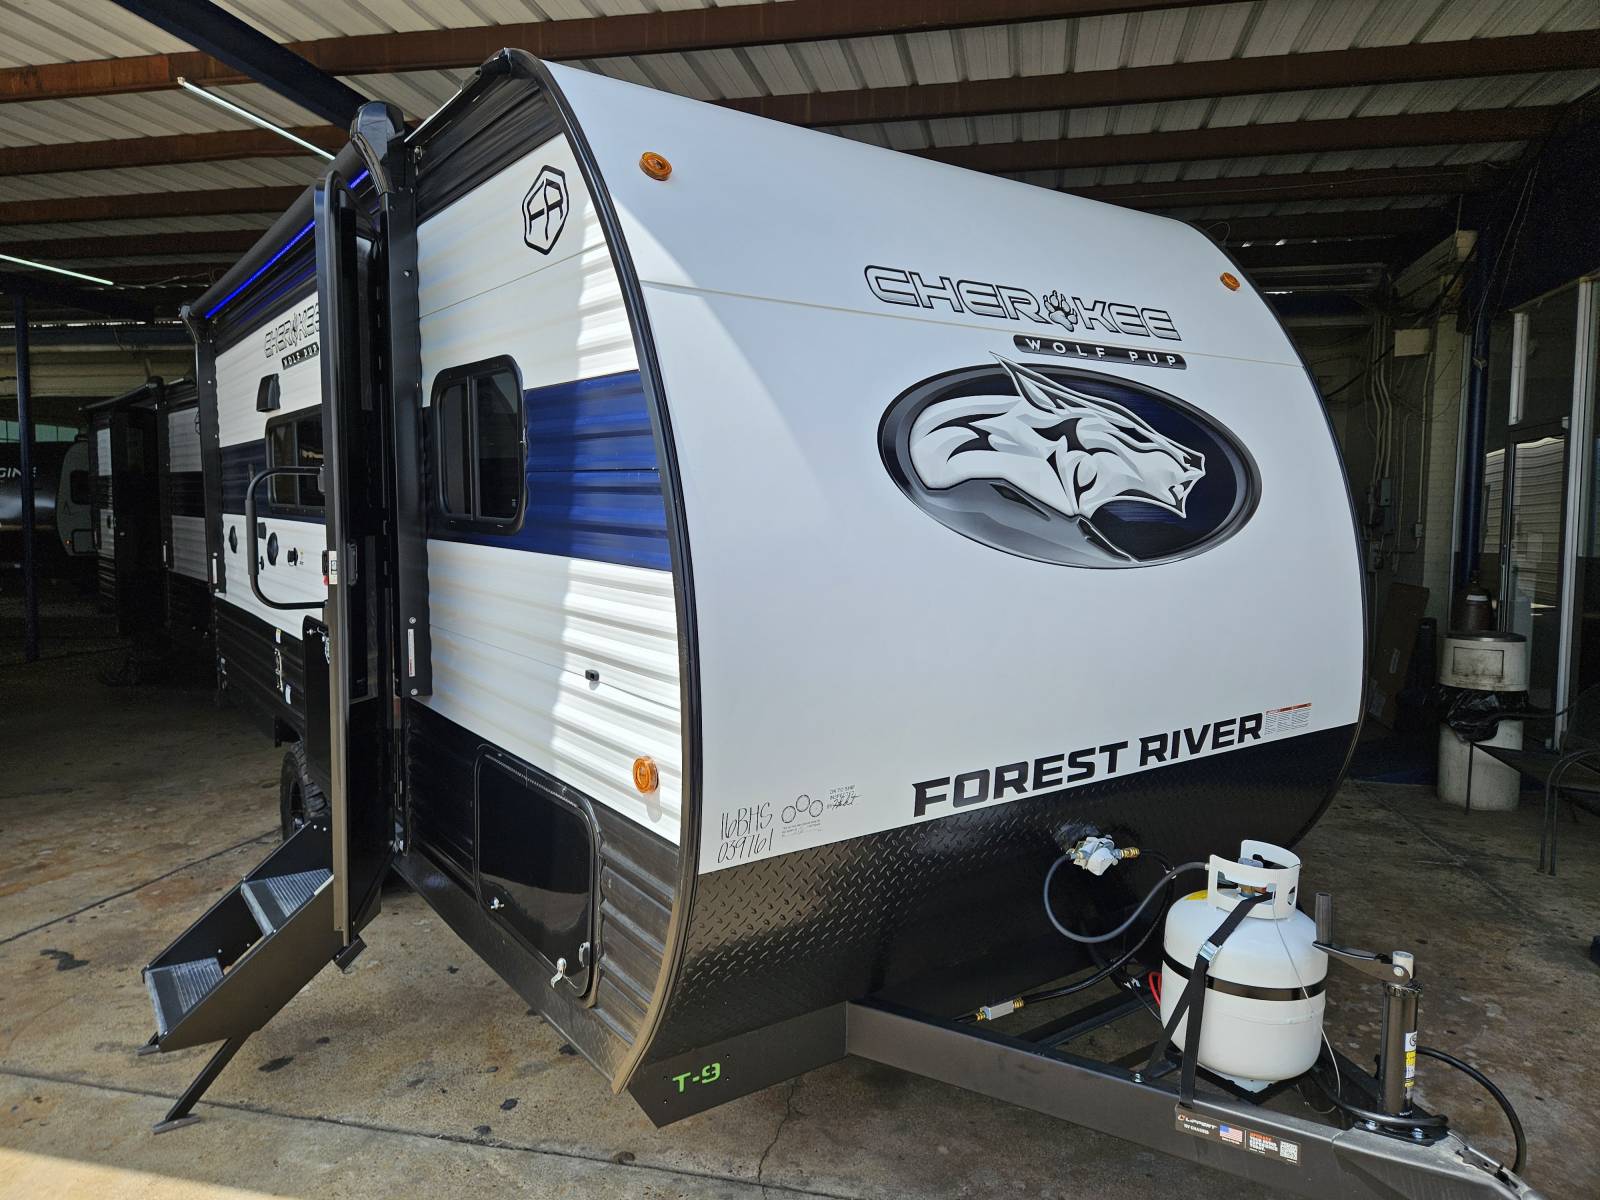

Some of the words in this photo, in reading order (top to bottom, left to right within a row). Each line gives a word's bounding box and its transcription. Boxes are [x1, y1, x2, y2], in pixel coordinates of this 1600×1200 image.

[1024, 337, 1106, 359] WOLF
[1128, 350, 1185, 367] PUP
[912, 740, 1129, 818] FOREST
[1138, 712, 1263, 767] RIVER
[672, 1062, 720, 1093] T-9
